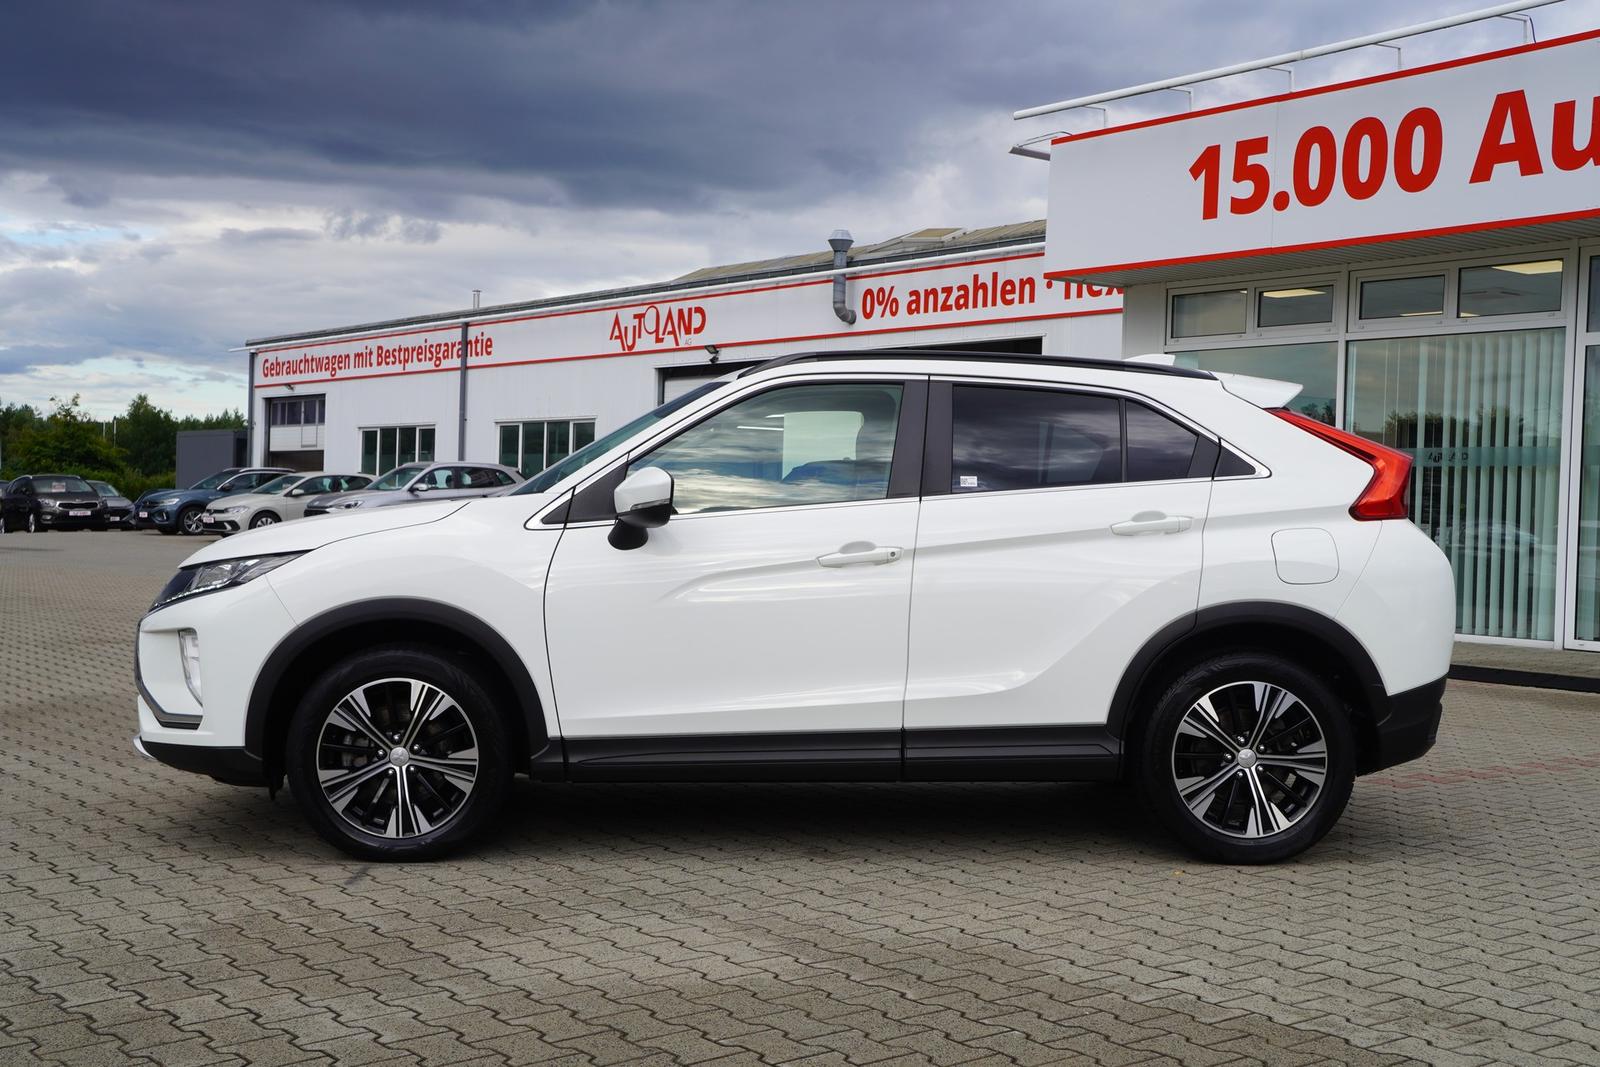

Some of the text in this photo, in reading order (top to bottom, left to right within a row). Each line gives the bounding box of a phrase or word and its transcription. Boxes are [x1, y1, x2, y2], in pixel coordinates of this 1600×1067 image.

[1189, 107, 1443, 220] 15.000
[861, 285, 899, 319] 0%
[906, 272, 1036, 316] anzahlen
[609, 305, 706, 352] AUTOLAND
[263, 352, 350, 377] Gebrauchtwagen
[354, 346, 373, 368] mit
